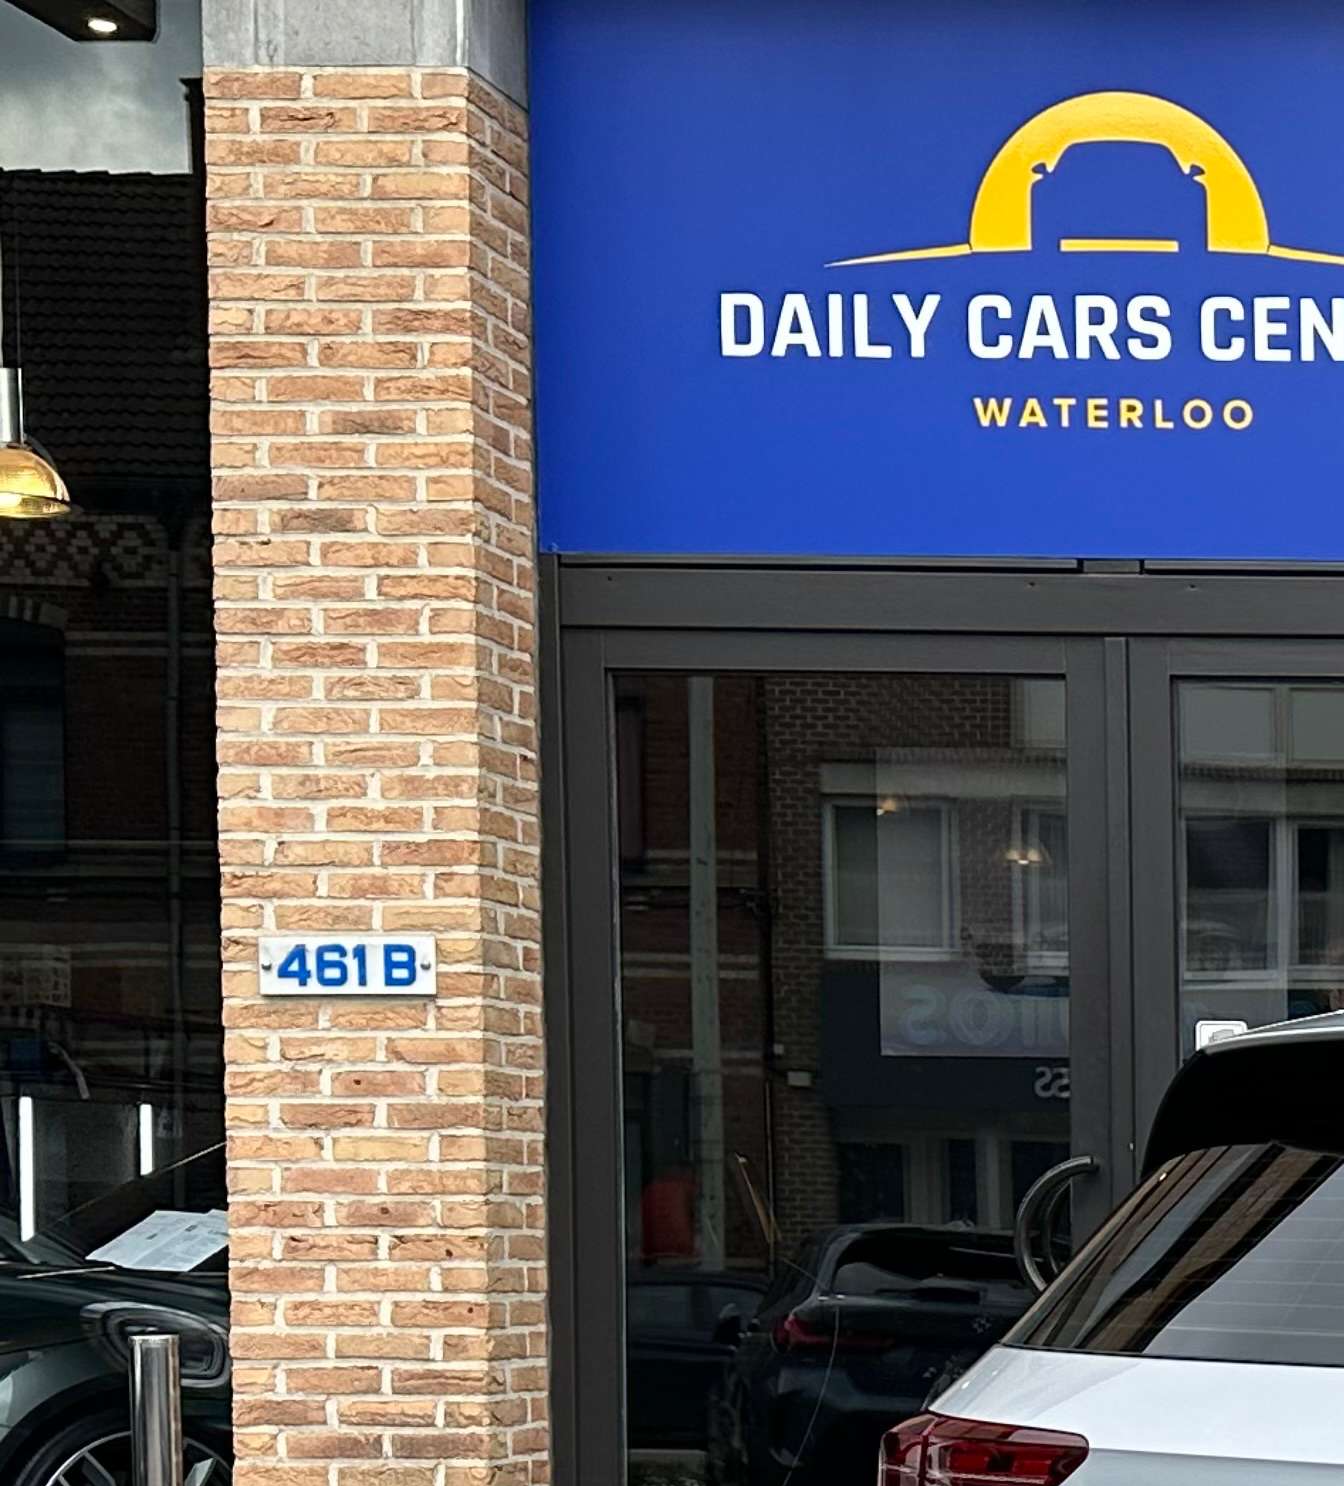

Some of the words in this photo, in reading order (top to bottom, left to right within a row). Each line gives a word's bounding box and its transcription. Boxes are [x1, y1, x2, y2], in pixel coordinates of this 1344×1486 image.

[719, 293, 942, 359] DAILY
[966, 294, 1173, 360] CARS
[973, 396, 1254, 431] WATERLOO
[277, 943, 368, 987] 461
